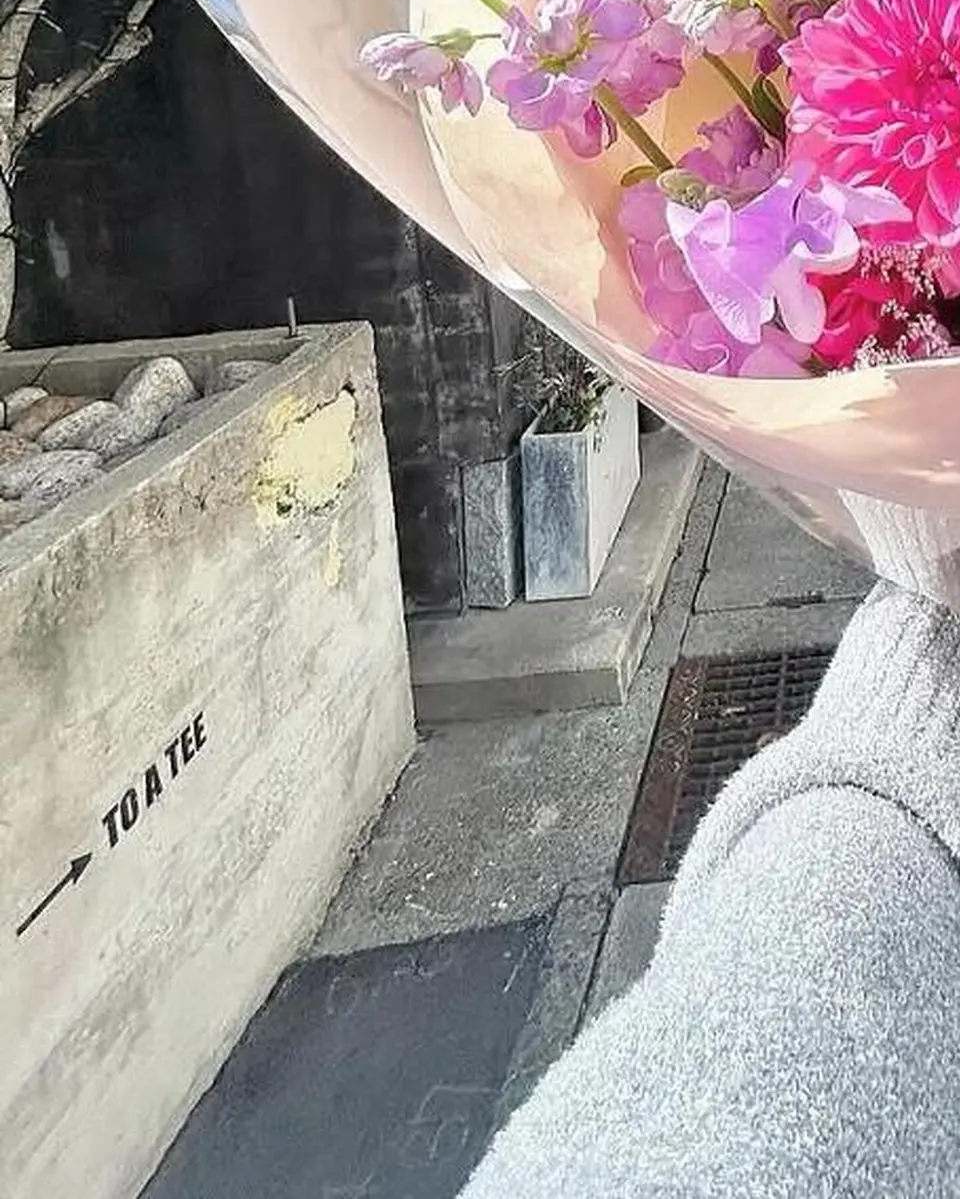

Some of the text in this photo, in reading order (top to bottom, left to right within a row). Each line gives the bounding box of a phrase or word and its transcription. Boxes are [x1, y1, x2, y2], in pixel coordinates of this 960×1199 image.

[102, 711, 207, 848] TO A TEE
